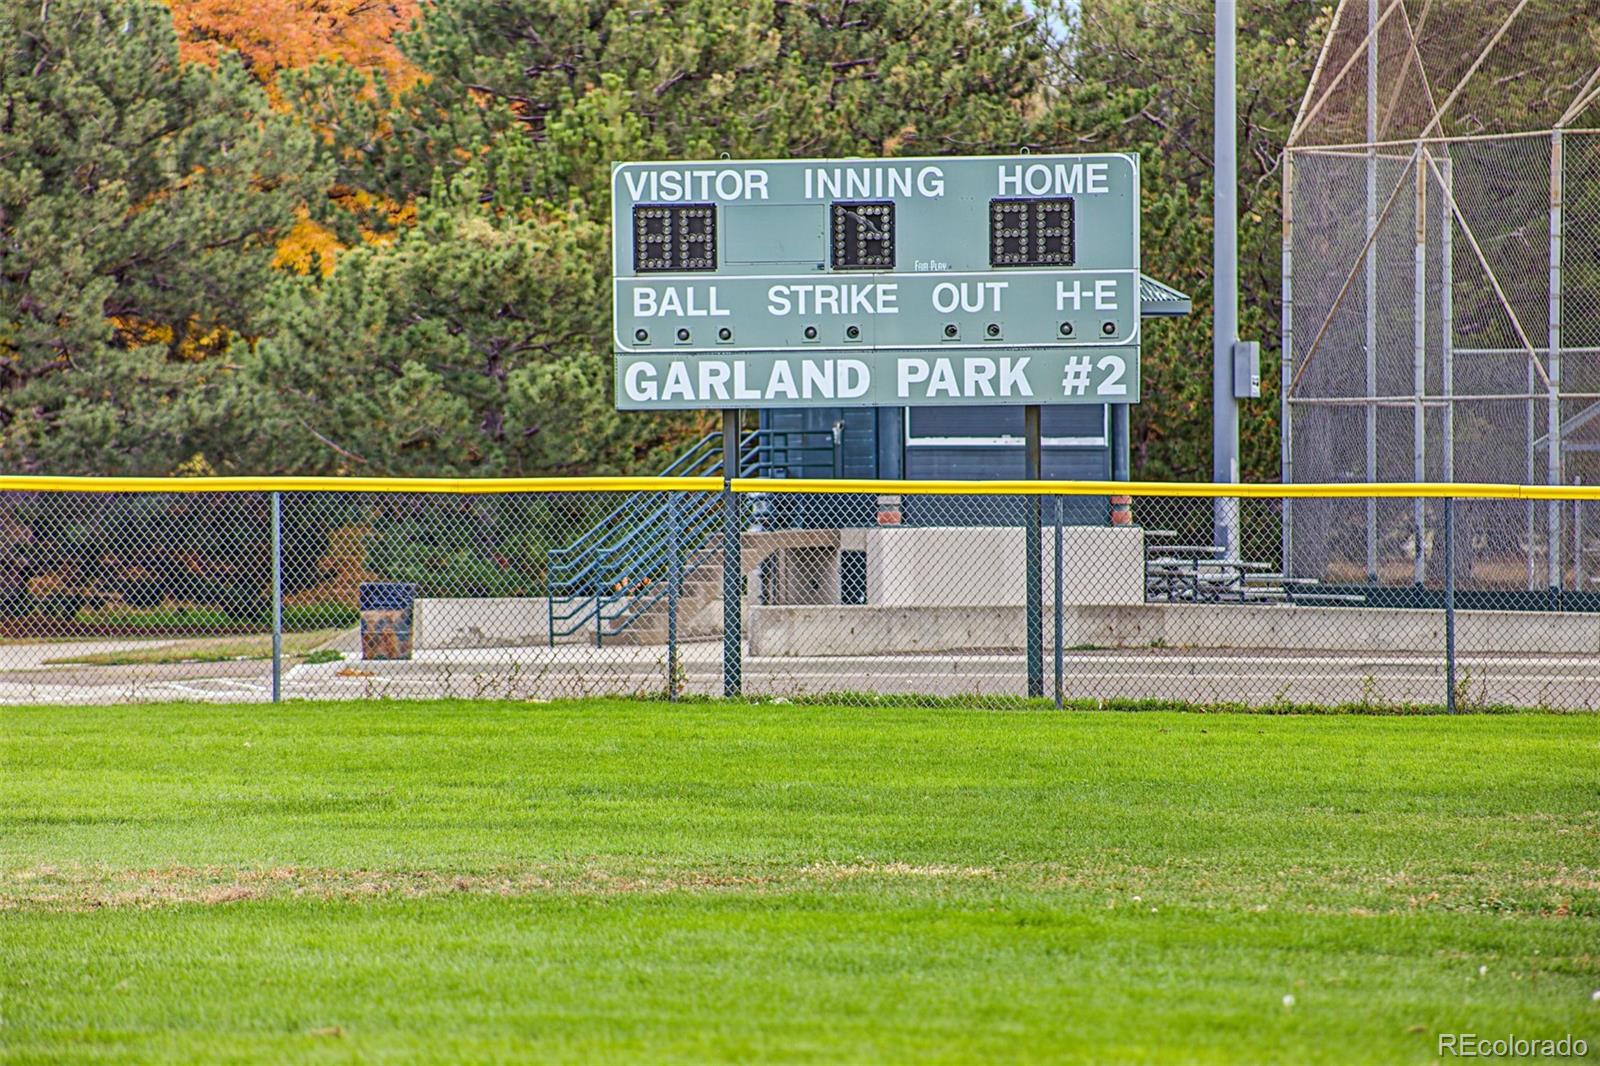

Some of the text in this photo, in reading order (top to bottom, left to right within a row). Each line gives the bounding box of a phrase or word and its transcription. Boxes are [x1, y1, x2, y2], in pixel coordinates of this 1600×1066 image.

[624, 163, 1109, 201] VISITOR INNING HOME
[634, 280, 1117, 317] BALL STRIKE OUT H-E
[624, 356, 1127, 401] GARLAND PARK #2
